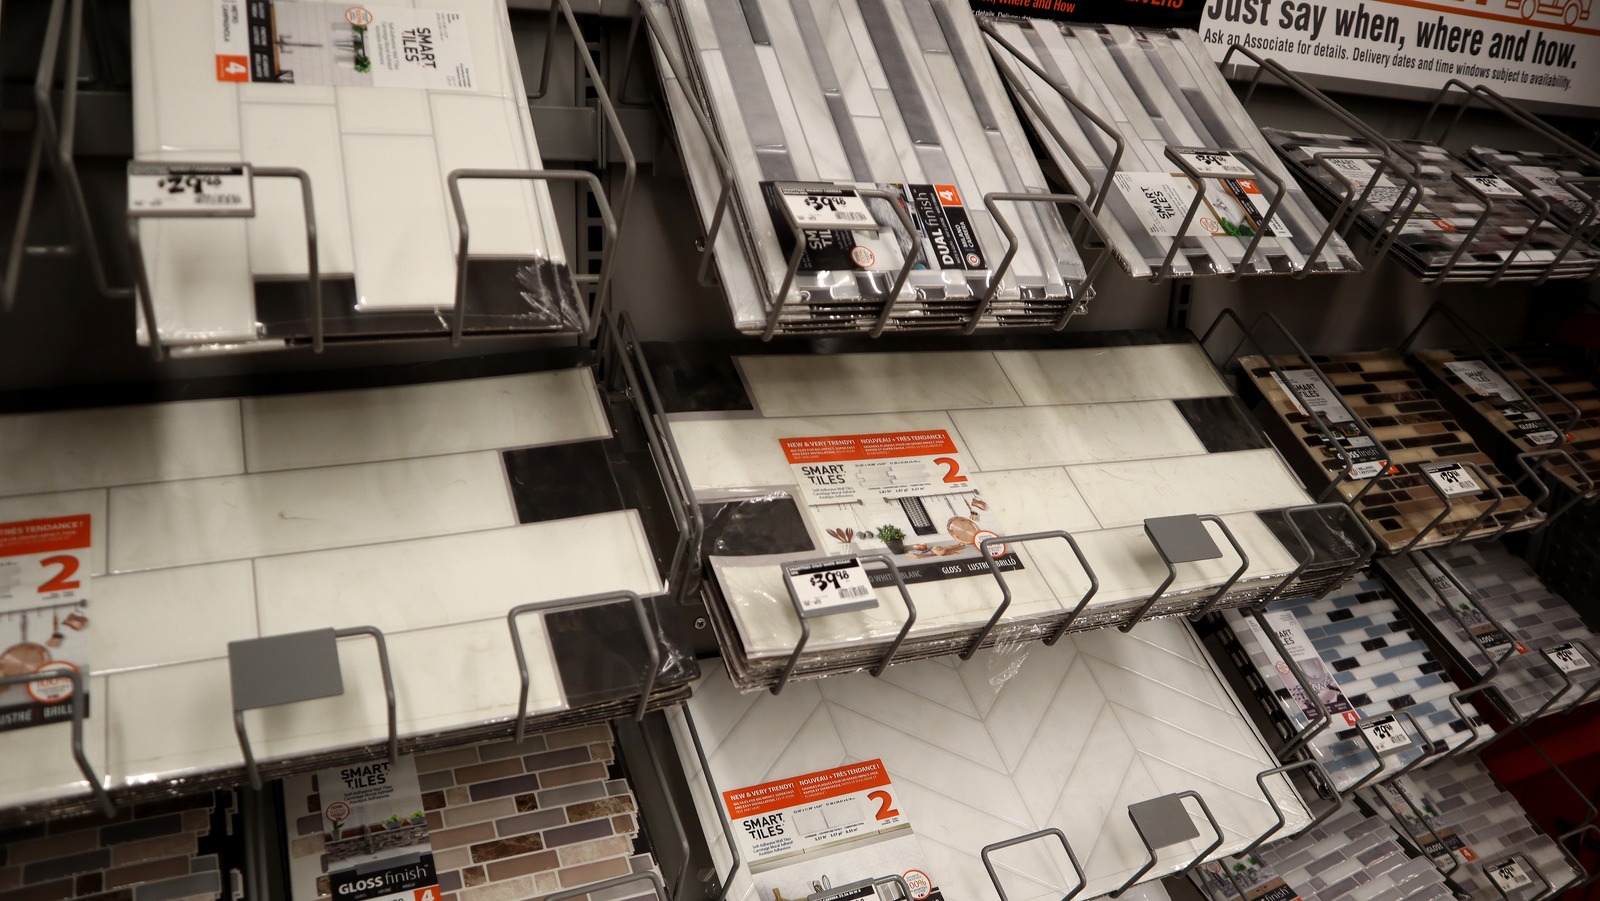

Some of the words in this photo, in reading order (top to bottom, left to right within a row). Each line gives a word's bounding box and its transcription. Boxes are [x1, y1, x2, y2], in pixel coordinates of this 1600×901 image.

[1054, 0, 1075, 13] How
[1207, 0, 1271, 26] Just
[1278, 0, 1327, 40] say
[1335, 3, 1405, 51] when,
[1417, 16, 1484, 56] where
[1488, 29, 1531, 62] and
[1531, 31, 1577, 69] how.
[401, 29, 420, 62] TILES
[416, 27, 436, 68] SMART
[225, 61, 247, 74] 4
[1204, 28, 1224, 44] Ask
[1227, 34, 1240, 46] an
[1243, 33, 1294, 53] Associate
[1297, 40, 1311, 55] for
[1314, 42, 1349, 60] details.
[1353, 47, 1391, 68] Delivery
[1392, 53, 1416, 68] dates
[1418, 58, 1433, 71] and
[1435, 59, 1454, 74] time
[1456, 62, 1491, 78] windows
[1492, 67, 1520, 84] subject
[1521, 70, 1528, 83] to
[1529, 73, 1571, 92] availability.
[1240, 181, 1251, 189] 4
[939, 190, 953, 201] 4
[1140, 187, 1169, 219] SMART
[916, 192, 939, 226] finish
[1154, 191, 1175, 217] TILES
[955, 224, 968, 248] MILANO
[960, 222, 974, 248] CARRERA
[932, 228, 954, 265] DUAL
[1294, 383, 1316, 391] MART
[1357, 448, 1379, 457] finish
[802, 464, 844, 476] SMART
[933, 457, 968, 483] 2
[808, 475, 845, 485] TILES
[26, 521, 78, 533] TENDANCE
[37, 555, 80, 593] 2
[901, 571, 922, 580] BLANC
[942, 565, 962, 574] GLOSS
[1479, 635, 1494, 643] LOSS
[43, 704, 73, 718] BRILL
[1347, 713, 1357, 723] 4
[341, 762, 390, 780] SMART
[800, 776, 828, 786] NOUVEAU
[848, 765, 876, 775] TENDANCE
[344, 774, 386, 789] TILES
[730, 793, 745, 801] NEW
[768, 782, 795, 791] TRENDY!
[867, 790, 900, 821] 2
[743, 813, 783, 831] SMART
[749, 824, 784, 840] TILES
[1464, 848, 1472, 857] 4
[339, 876, 383, 894] GLOSS
[385, 866, 427, 885] finish
[909, 879, 926, 889] 00%
[421, 889, 434, 901] 4
